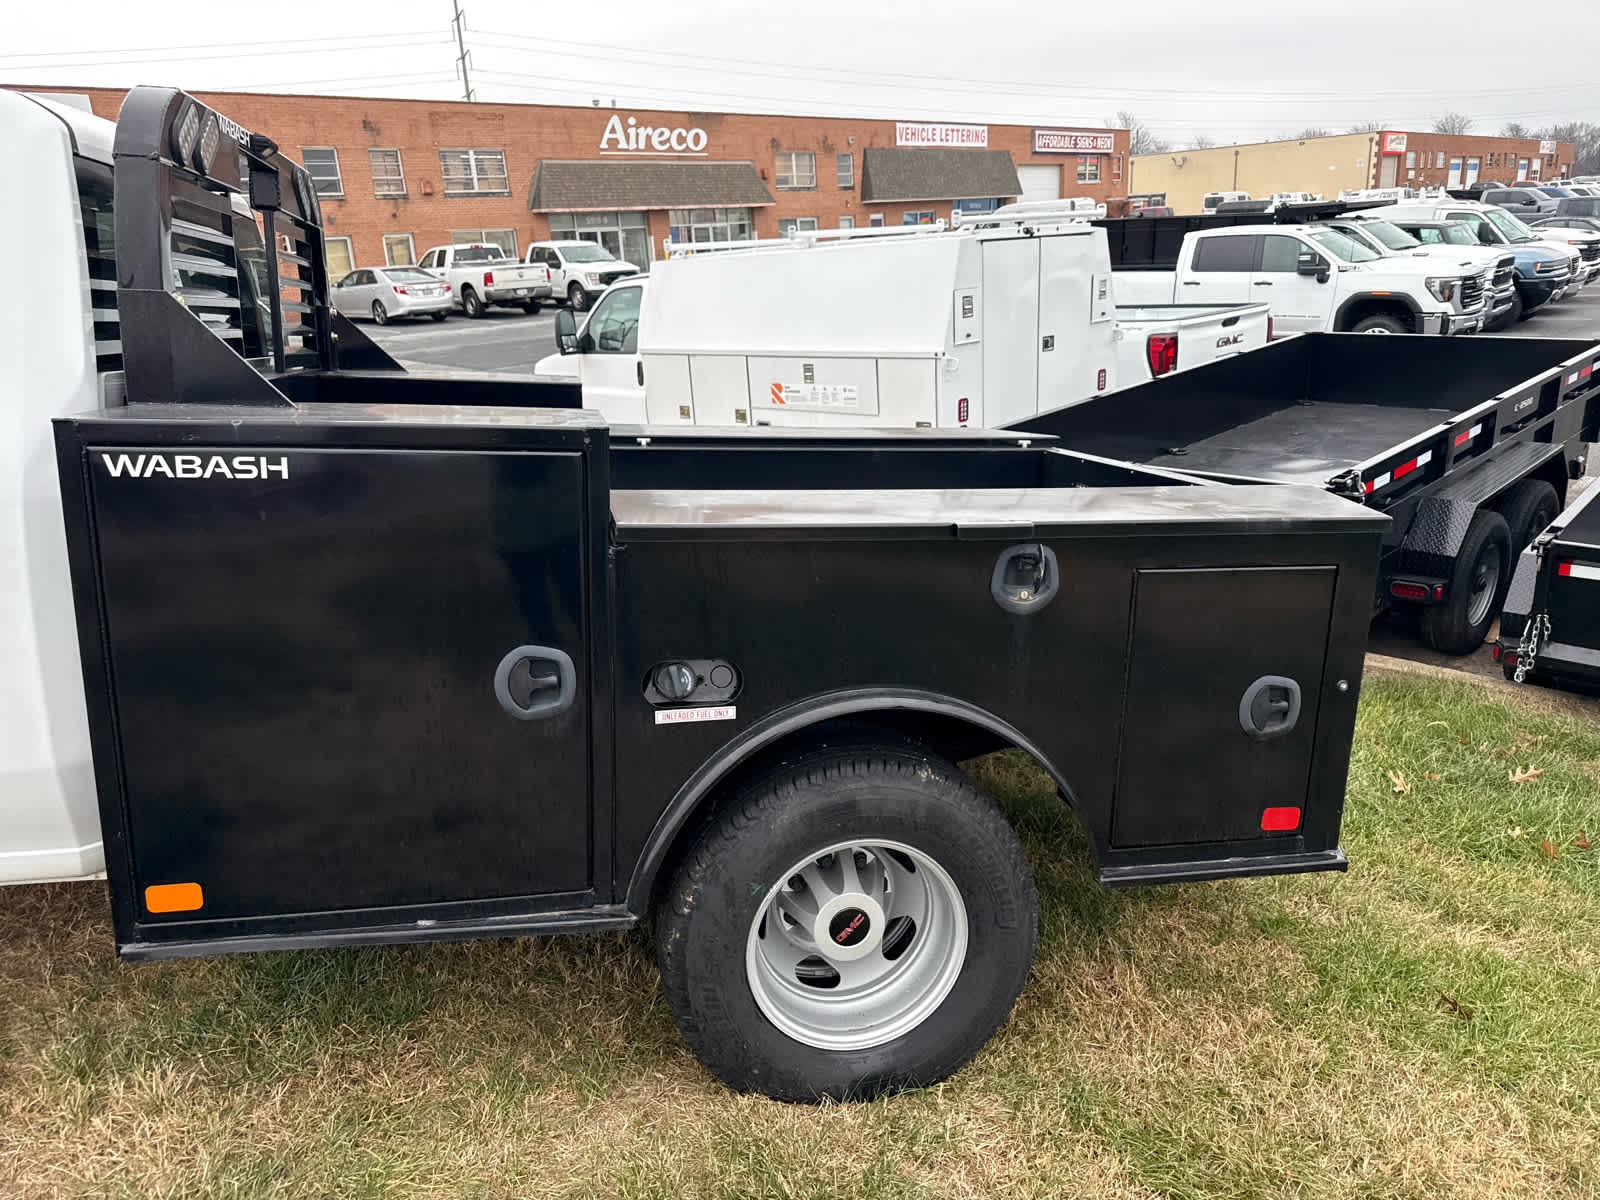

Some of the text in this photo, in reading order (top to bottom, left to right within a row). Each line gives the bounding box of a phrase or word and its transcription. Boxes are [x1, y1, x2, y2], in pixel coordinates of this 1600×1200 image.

[216, 112, 251, 148] WABASH
[599, 114, 708, 151] Aireco
[898, 127, 986, 144] VEHICLE LETTERING
[1038, 134, 1076, 149] AFFORDABLE
[1076, 135, 1094, 149] SIGNS
[1096, 136, 1113, 150] NEON
[1216, 332, 1244, 348] GMC
[101, 453, 289, 480] WABASH
[661, 709, 729, 720] UNLEADED FUEL ONLY
[836, 912, 865, 942] GMC
